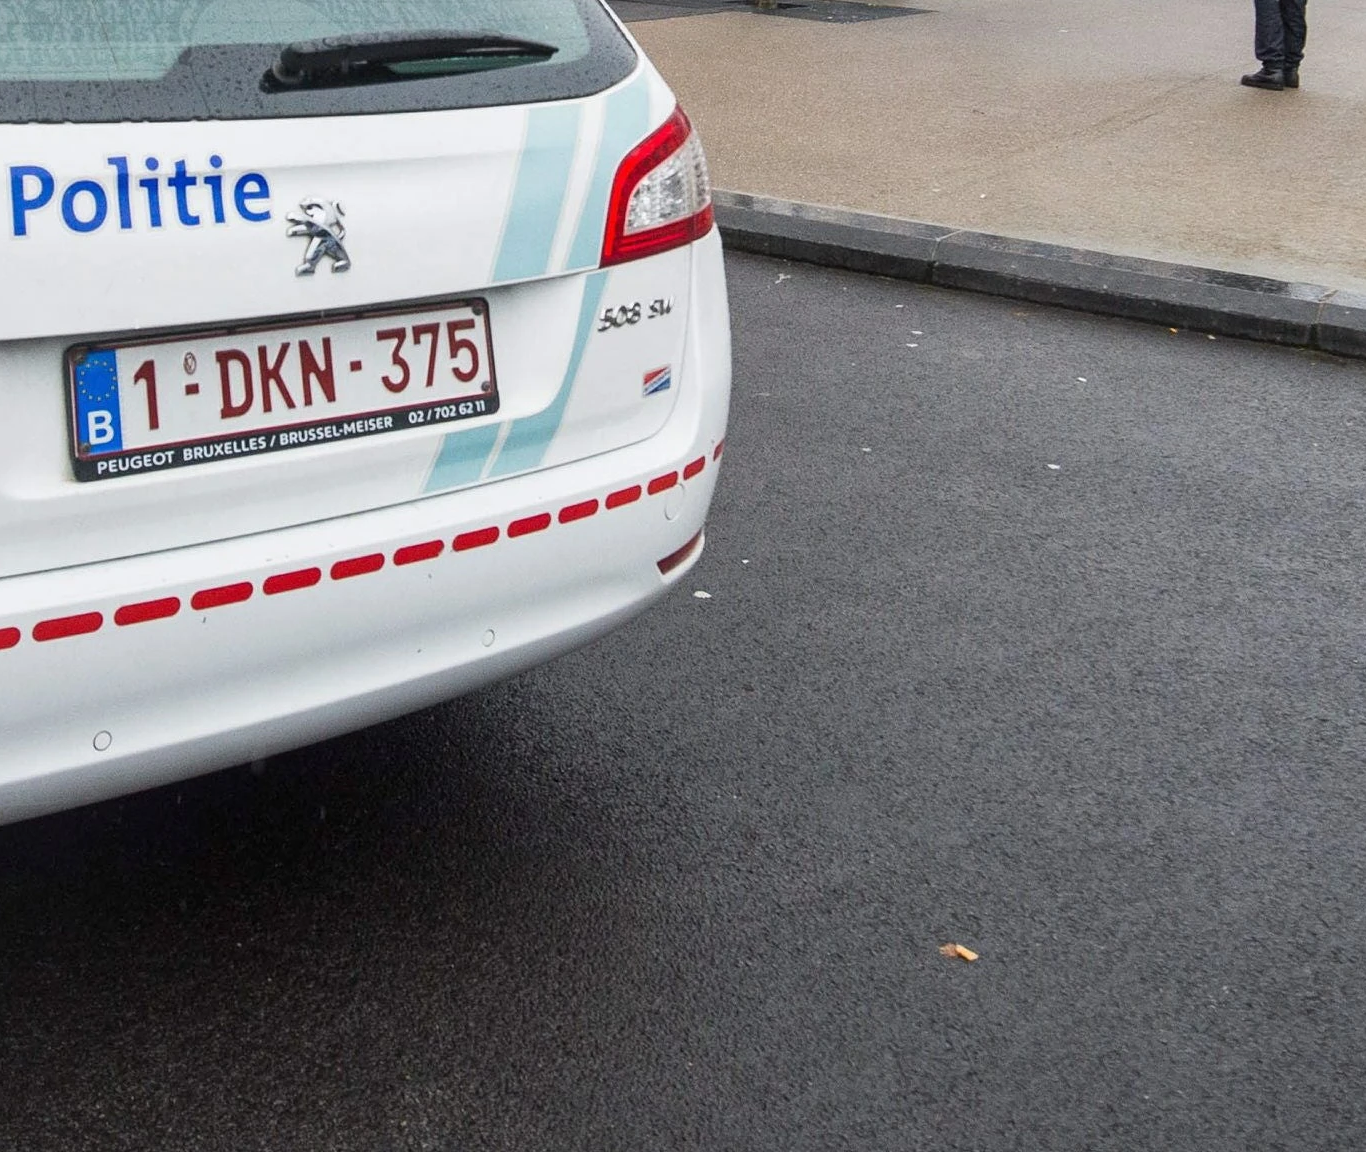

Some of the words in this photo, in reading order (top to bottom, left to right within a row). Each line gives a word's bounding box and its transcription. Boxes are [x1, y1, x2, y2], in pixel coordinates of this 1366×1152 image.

[9, 155, 272, 236] Politie
[597, 301, 642, 333] 508
[647, 297, 673, 319] SW
[87, 409, 115, 446] B
[97, 450, 175, 475] PEUGEOT
[183, 434, 267, 462] BRUXELLES
[279, 415, 393, 446] BRUSSEL-MEISER
[408, 410, 424, 424] 02
[434, 404, 457, 421] 702
[458, 401, 474, 416] 62
[475, 399, 486, 412] 11
